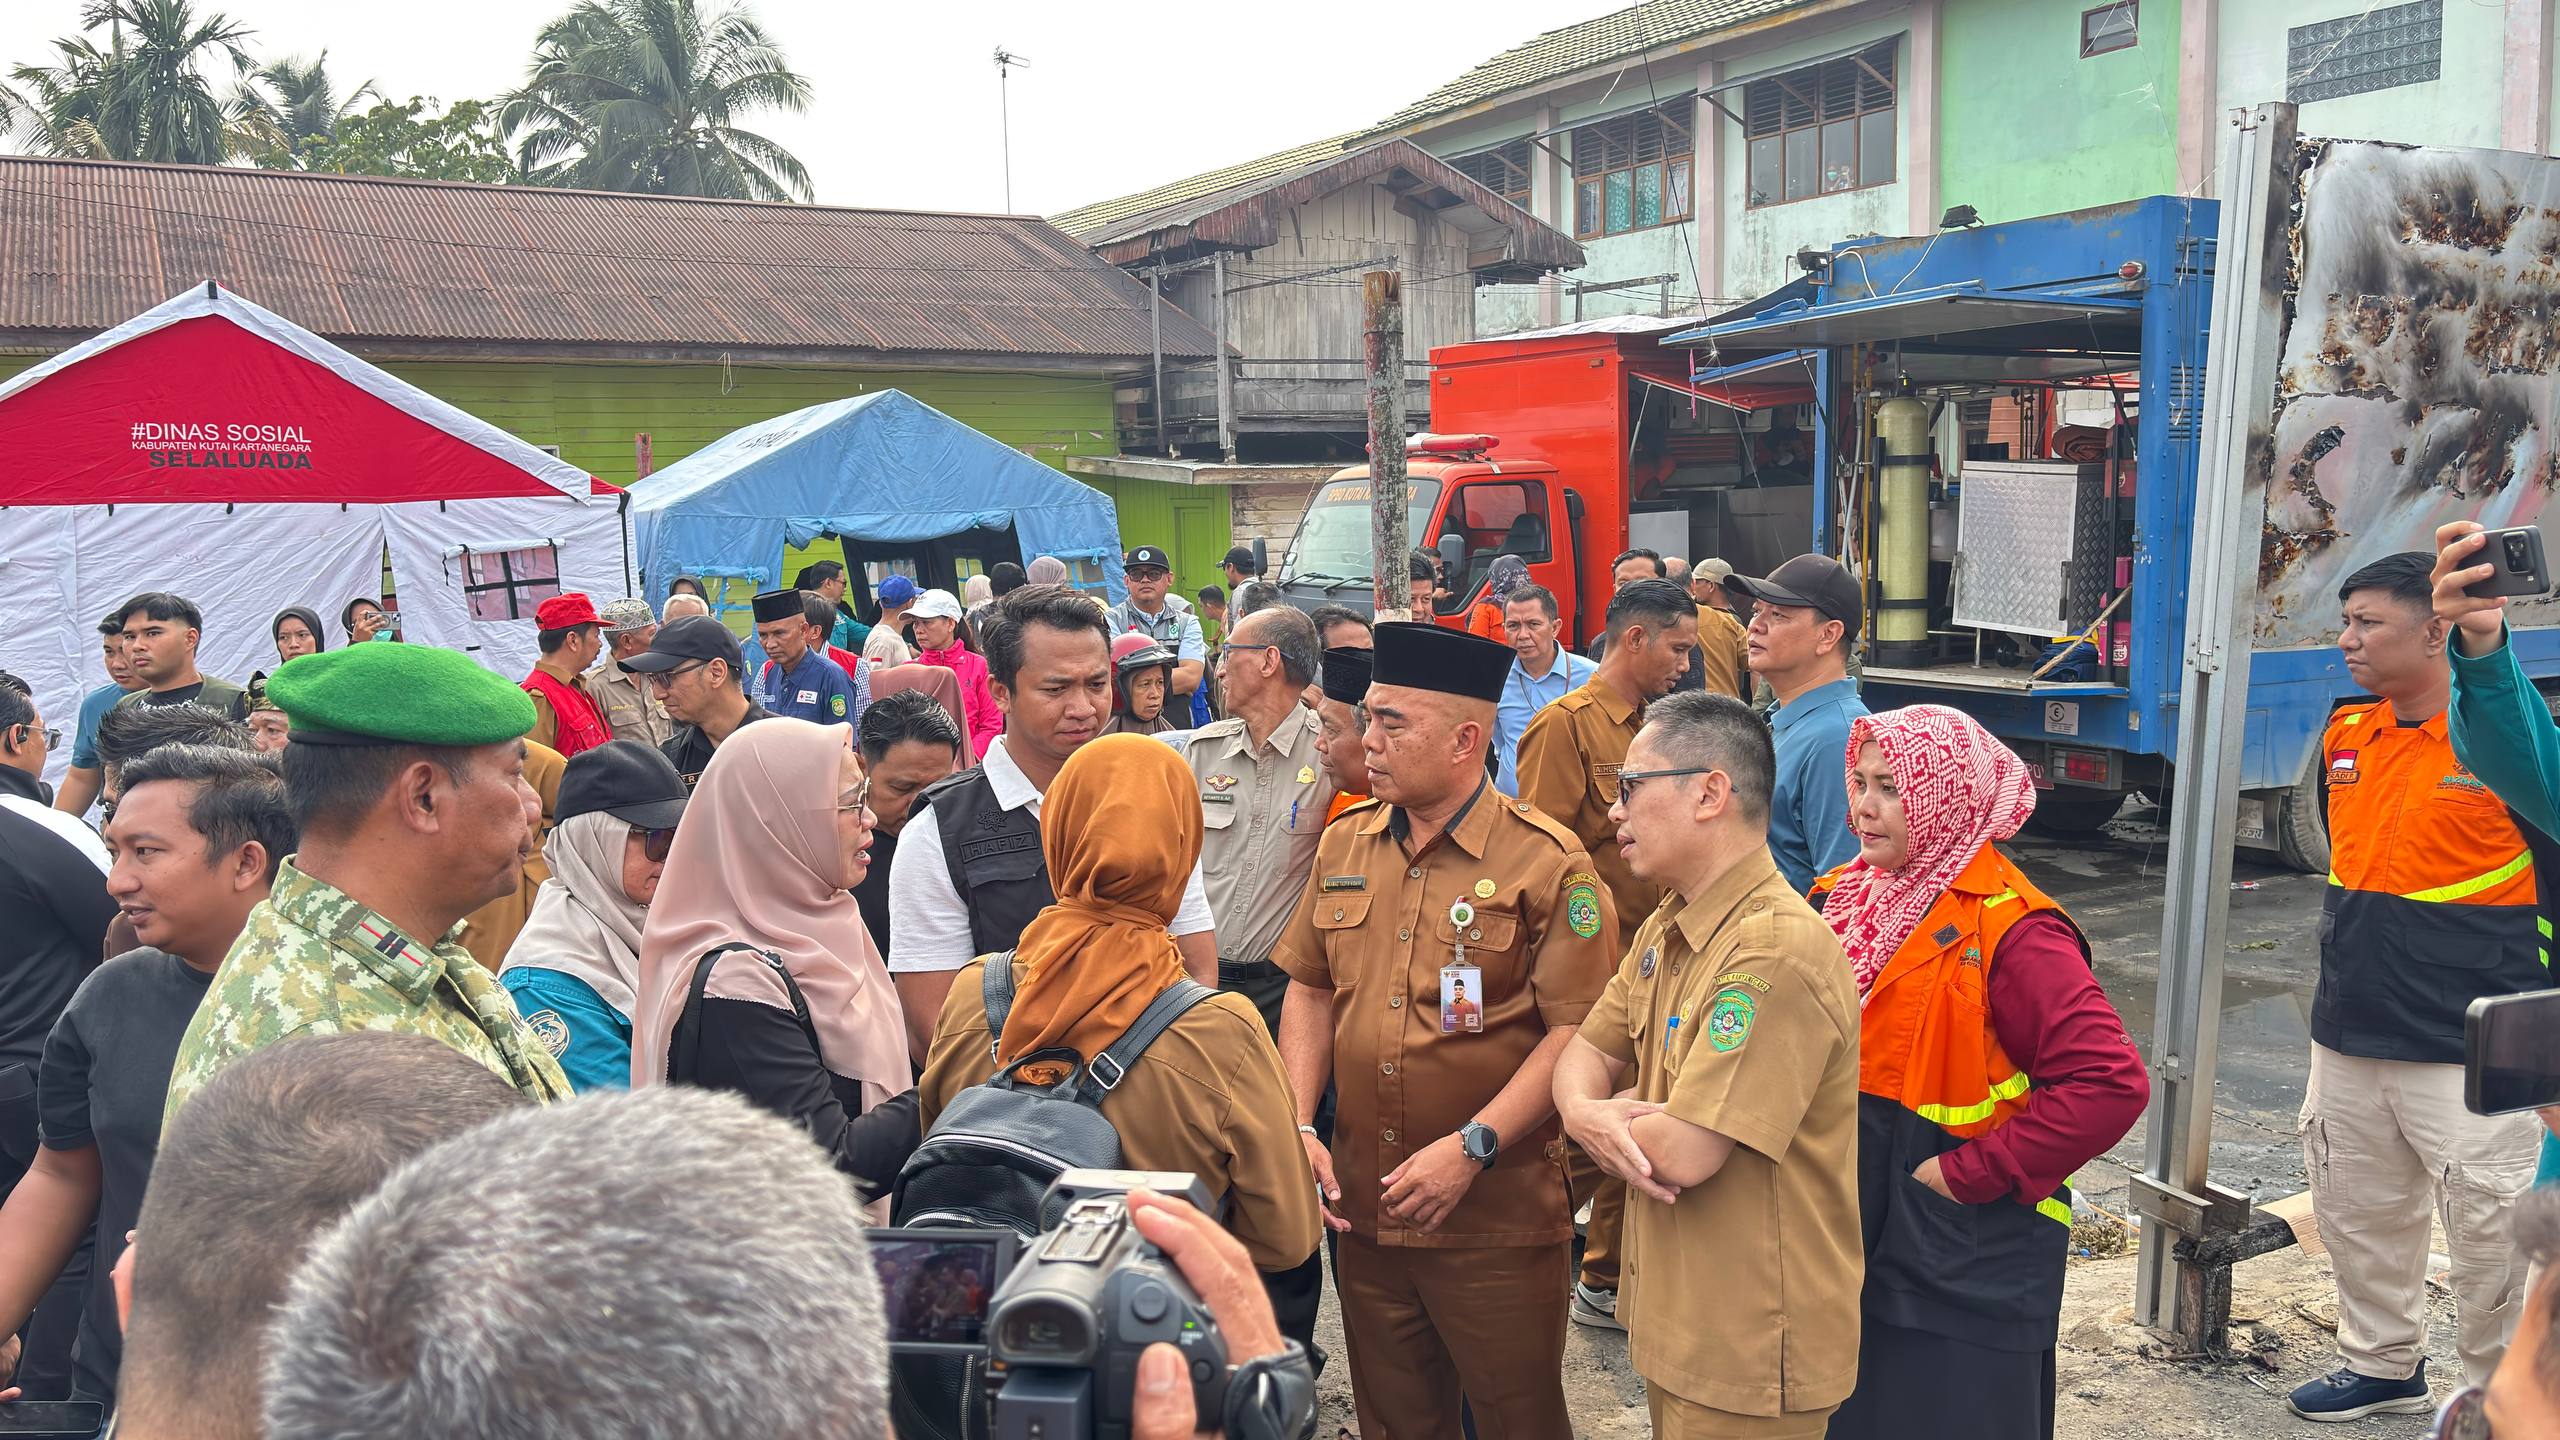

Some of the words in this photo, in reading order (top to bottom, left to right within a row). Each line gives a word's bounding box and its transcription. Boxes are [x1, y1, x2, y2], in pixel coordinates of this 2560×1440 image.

[131, 423, 219, 441] #DINAS
[227, 424, 312, 443] SOSIAL
[132, 441, 197, 450] KABUPATEN
[199, 442, 230, 451] KUTAI
[233, 442, 312, 453] KARTANEGARA
[150, 450, 312, 470] SELALUADA
[970, 836, 1027, 856] HAFIZ
